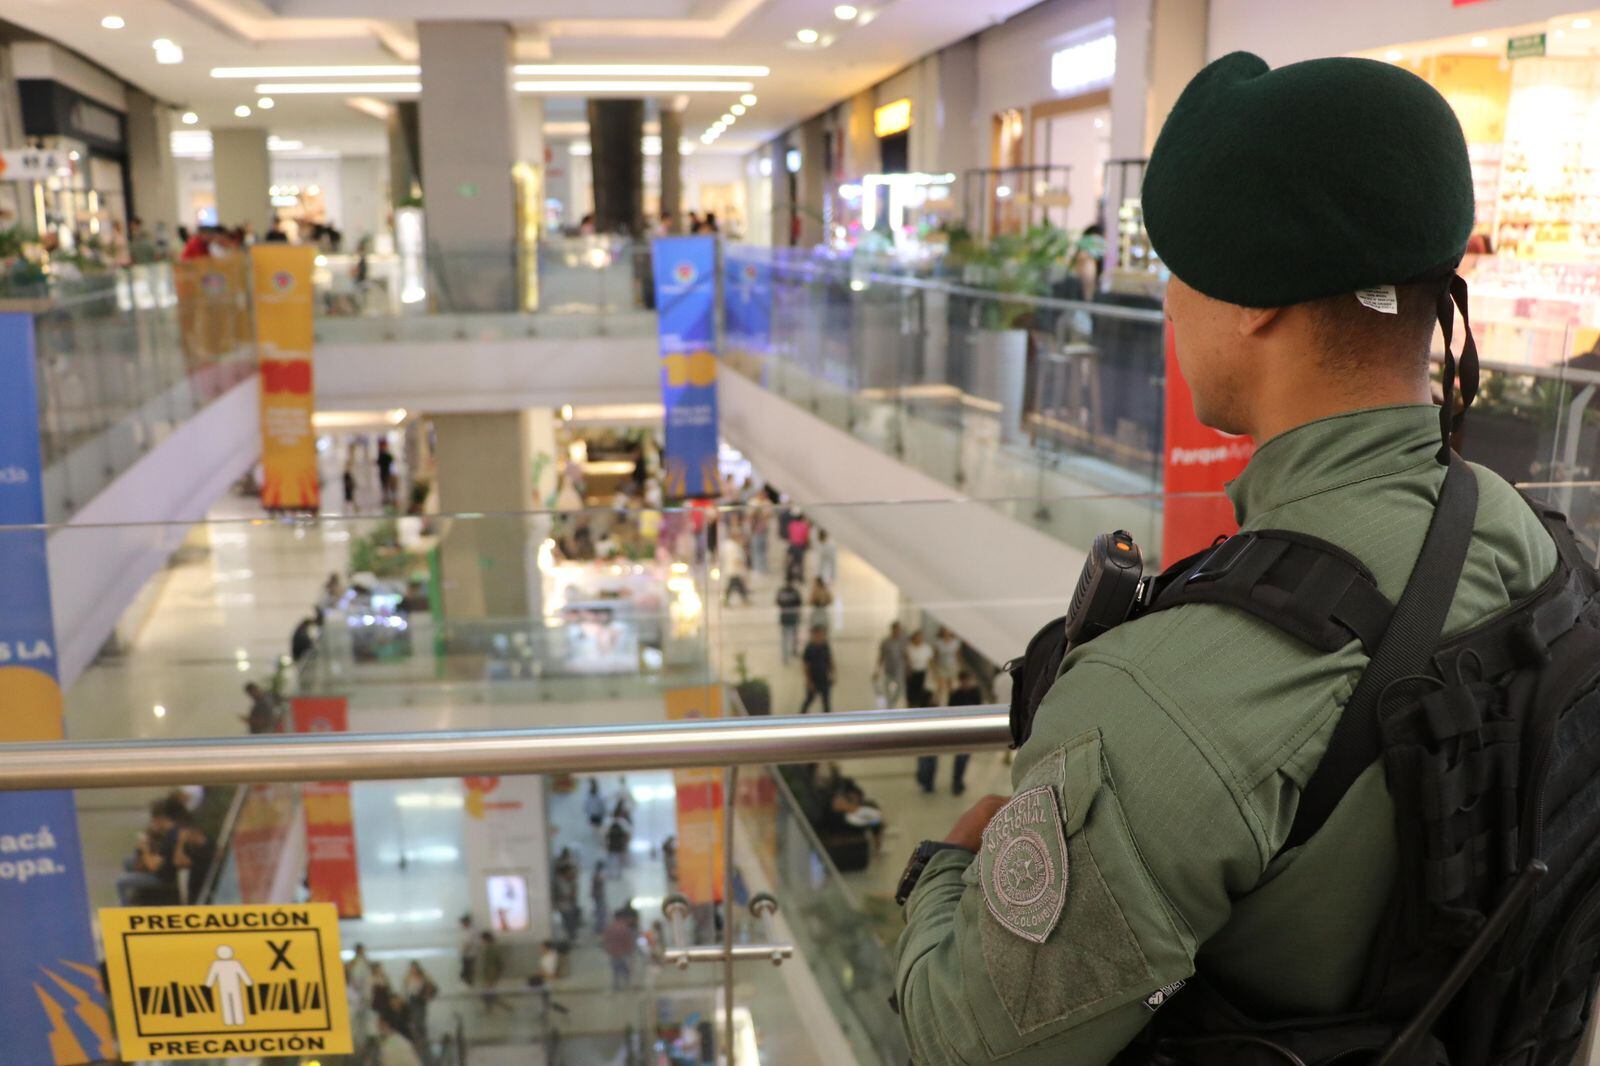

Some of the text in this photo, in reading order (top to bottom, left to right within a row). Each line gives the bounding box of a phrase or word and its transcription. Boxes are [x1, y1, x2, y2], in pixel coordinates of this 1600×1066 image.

[17, 640, 53, 659] LA
[0, 826, 56, 852] acá
[987, 809, 1046, 853] NACIONAL
[129, 908, 310, 930] PRECAUCIÓN
[1014, 903, 1057, 927] COLOMBIA
[148, 1033, 325, 1056] PRECAUCIÓN
